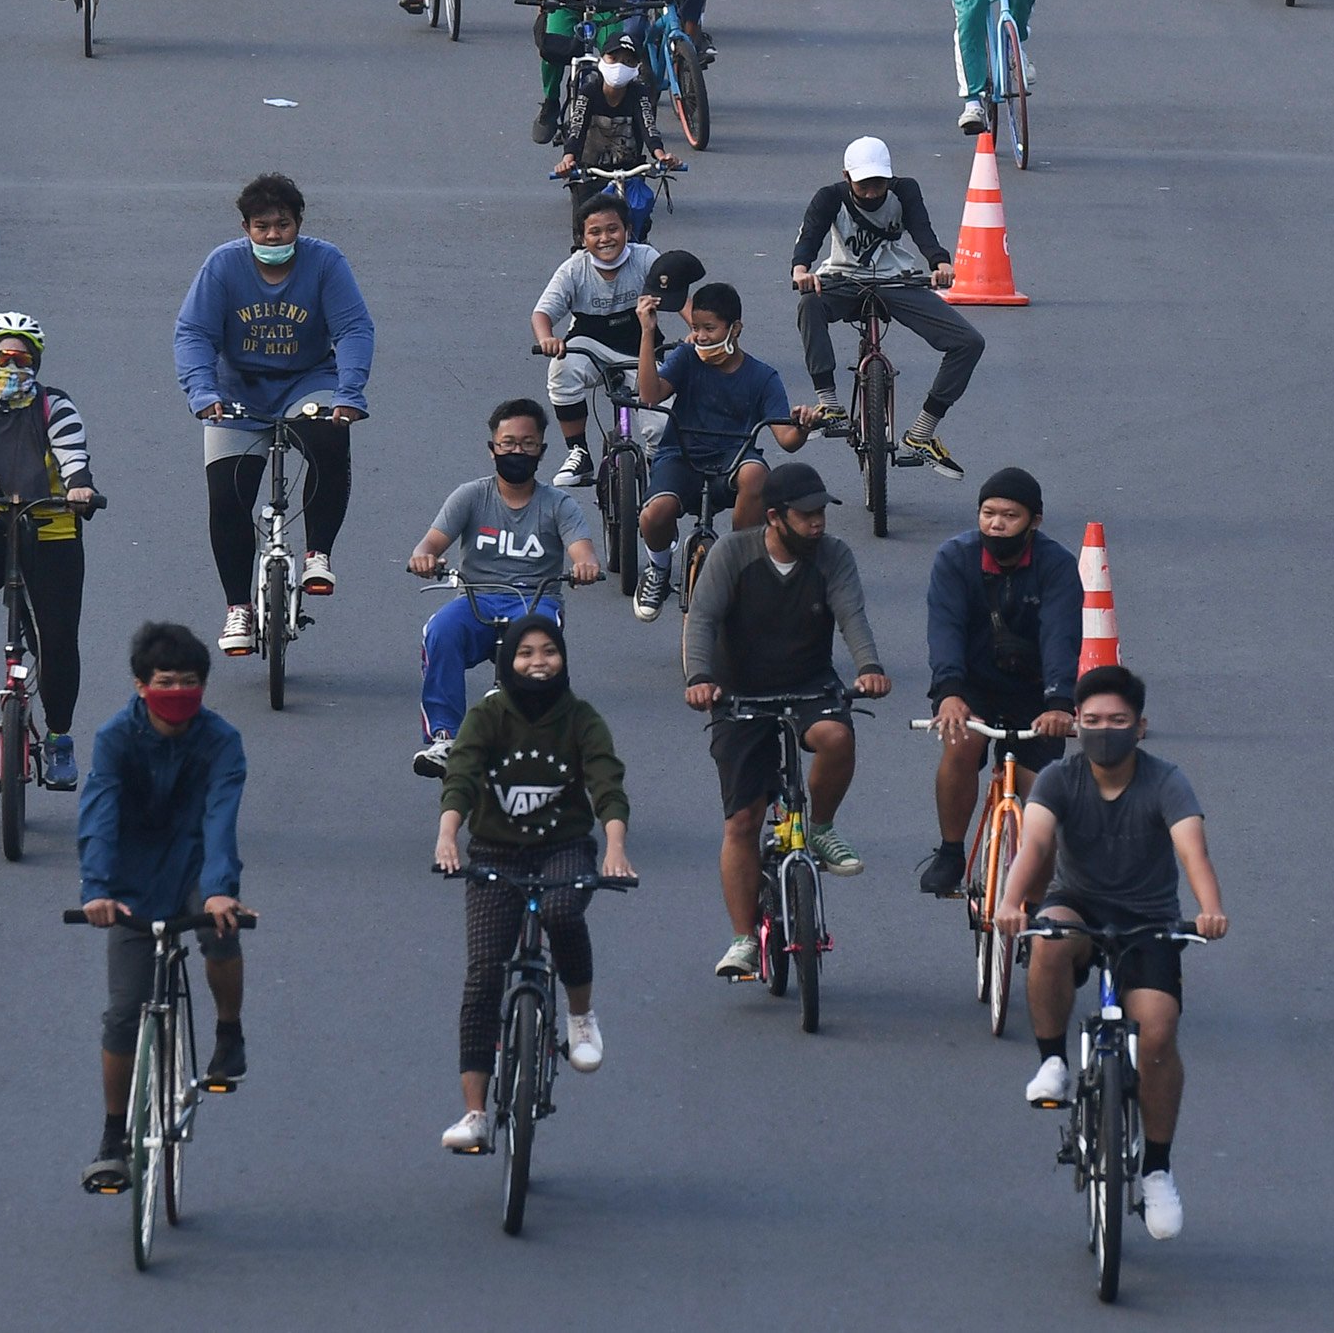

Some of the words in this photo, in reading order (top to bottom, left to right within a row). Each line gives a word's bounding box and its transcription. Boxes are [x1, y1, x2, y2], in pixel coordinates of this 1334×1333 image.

[250, 324, 294, 339] STATE
[242, 337, 259, 352] OF
[264, 340, 299, 355] MIND
[476, 527, 545, 558] FILA
